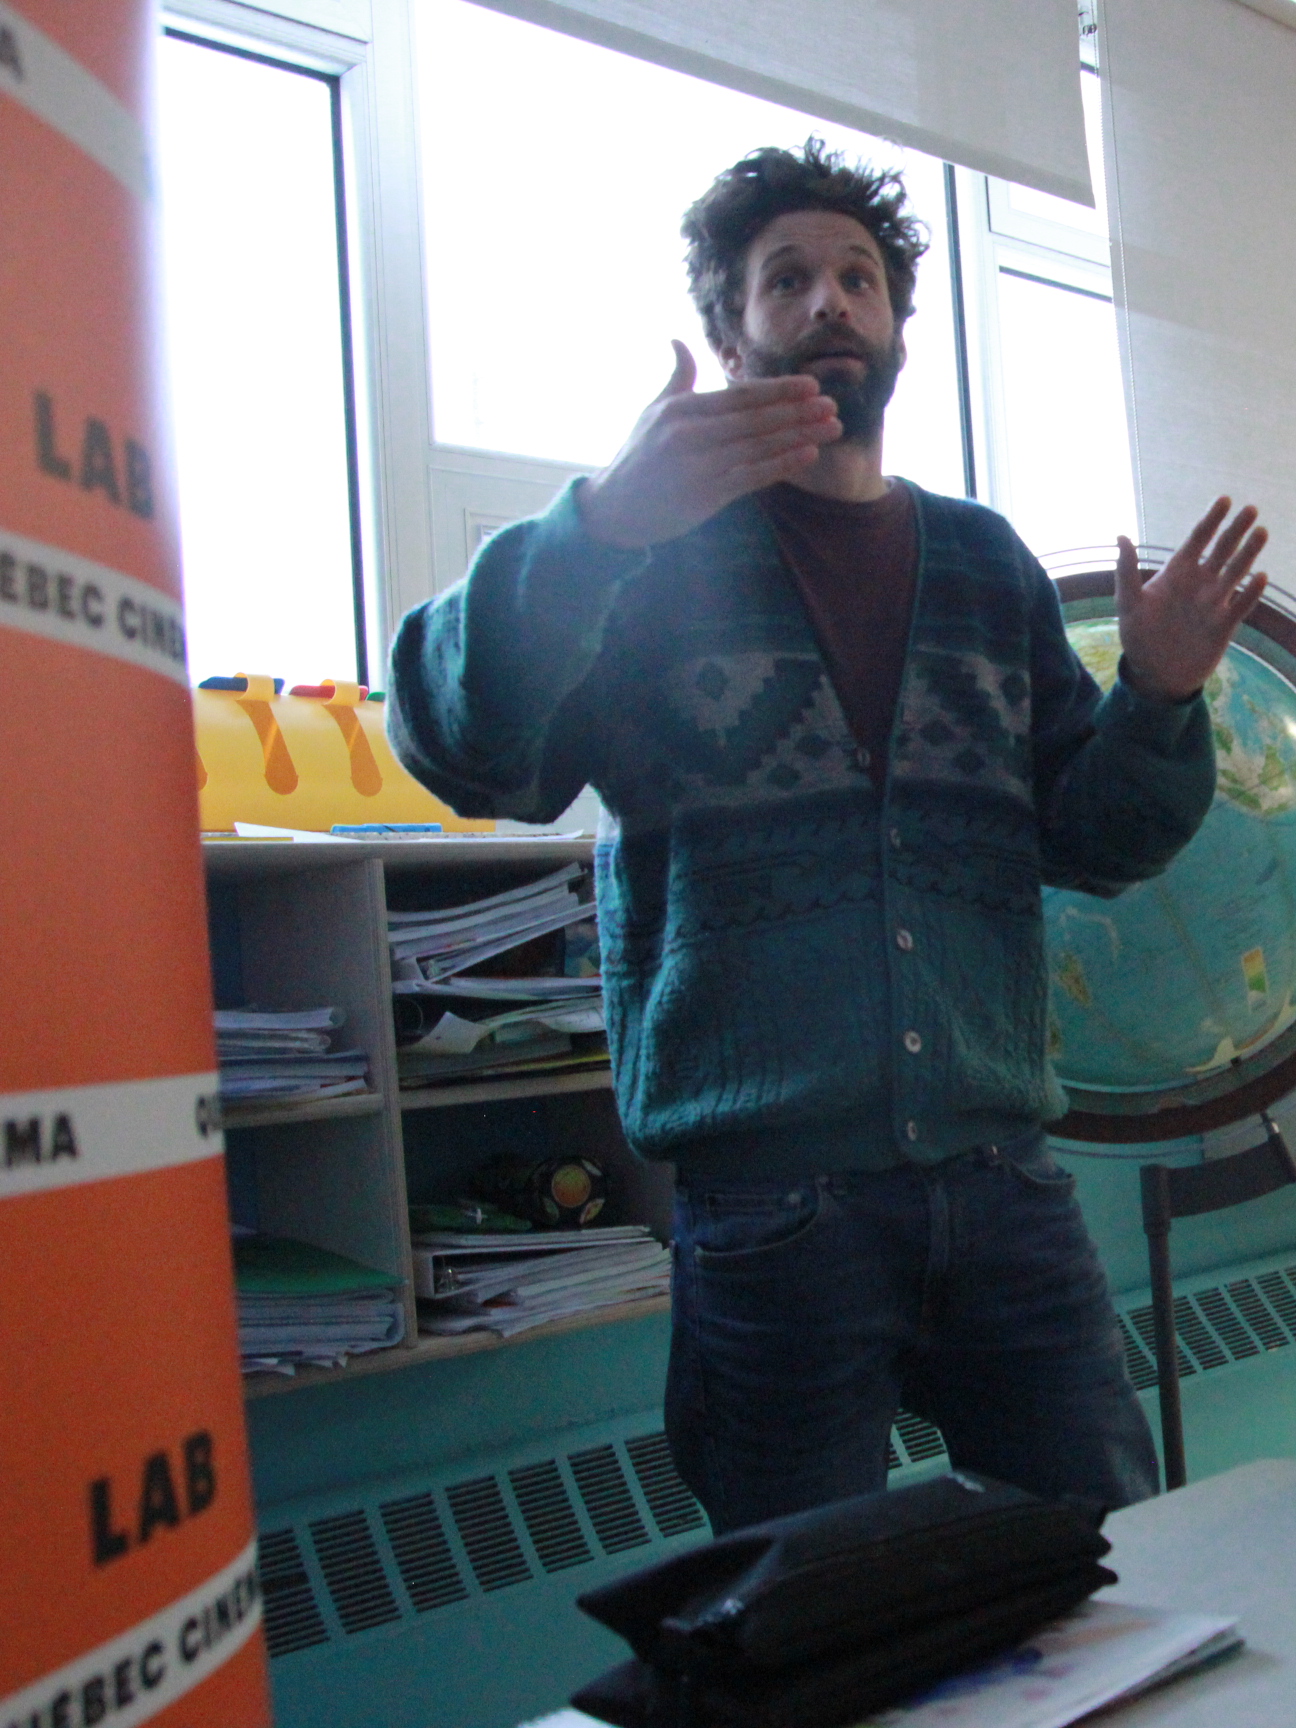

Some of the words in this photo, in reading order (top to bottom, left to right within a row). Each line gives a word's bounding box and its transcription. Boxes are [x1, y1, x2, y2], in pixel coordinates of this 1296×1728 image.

[34, 388, 155, 520] LAB
[5, 1111, 78, 1168] MA
[91, 1429, 217, 1569] LAB
